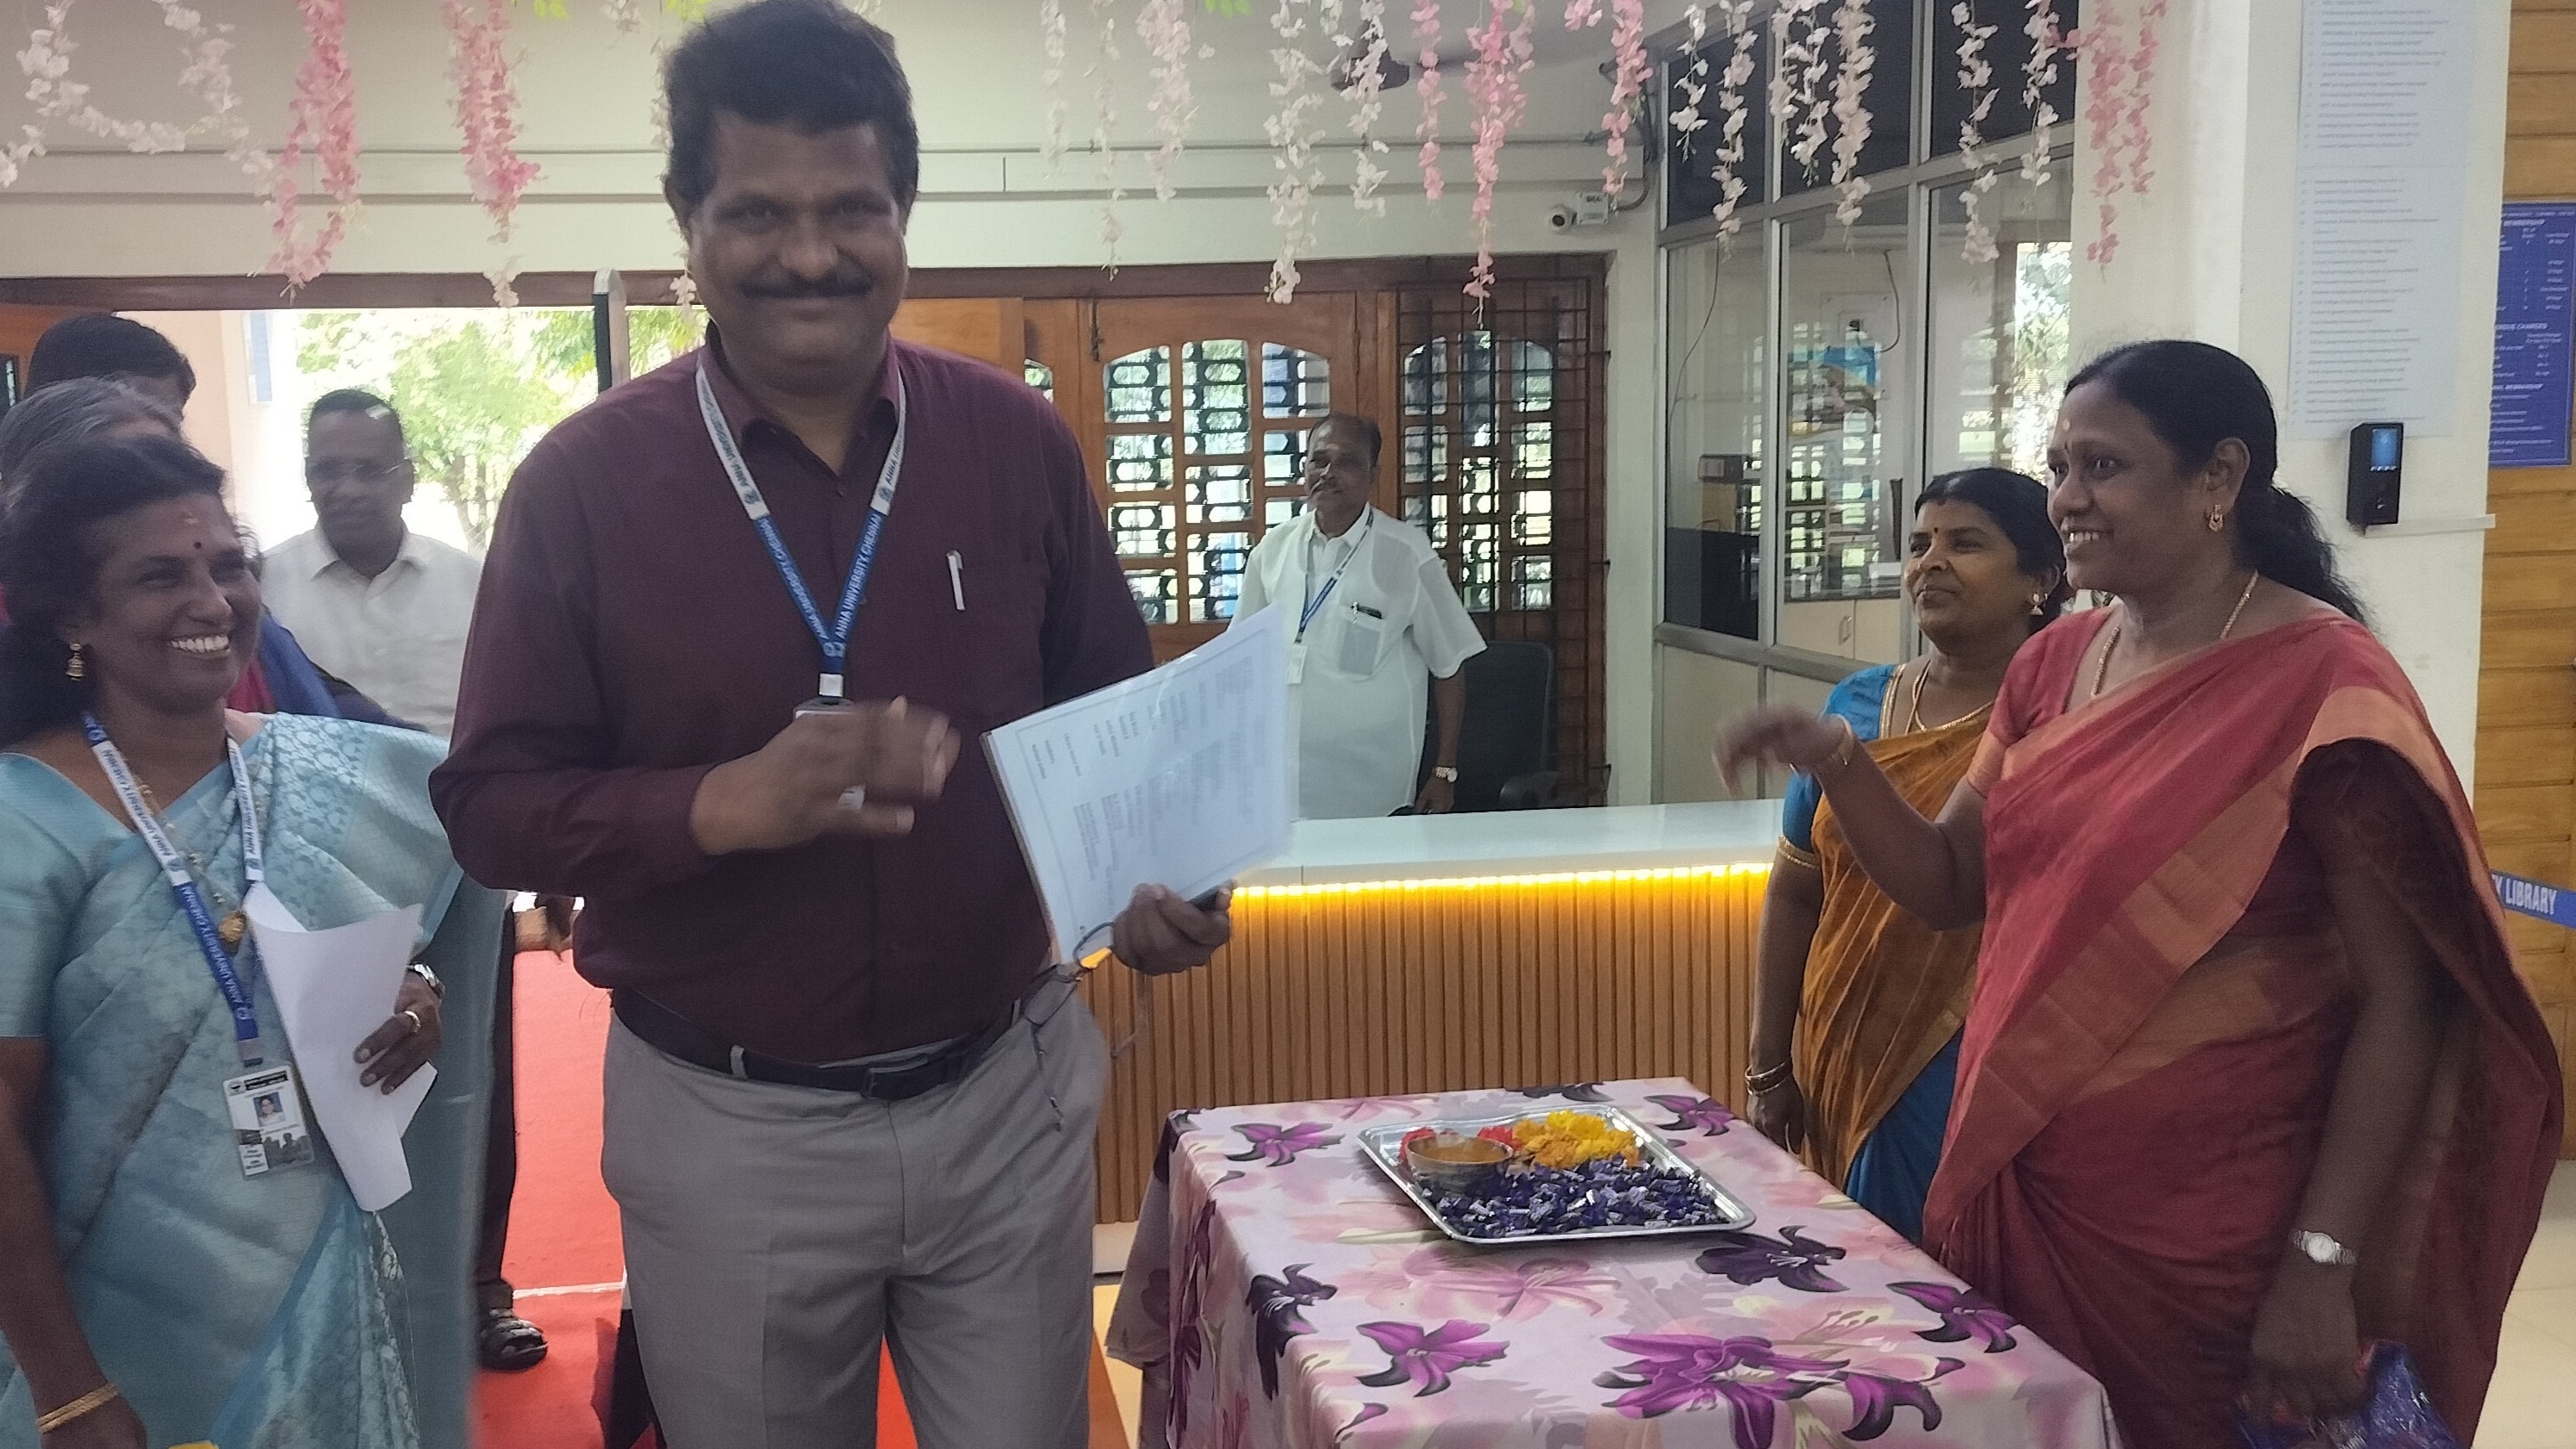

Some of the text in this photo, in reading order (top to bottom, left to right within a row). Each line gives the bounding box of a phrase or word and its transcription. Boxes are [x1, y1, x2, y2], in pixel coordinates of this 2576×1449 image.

[835, 610, 853, 639] ANNA
[862, 513, 881, 556] CHENNAI
[2505, 877, 2557, 915] LIBRARY
[224, 978, 244, 1004] ANNA
